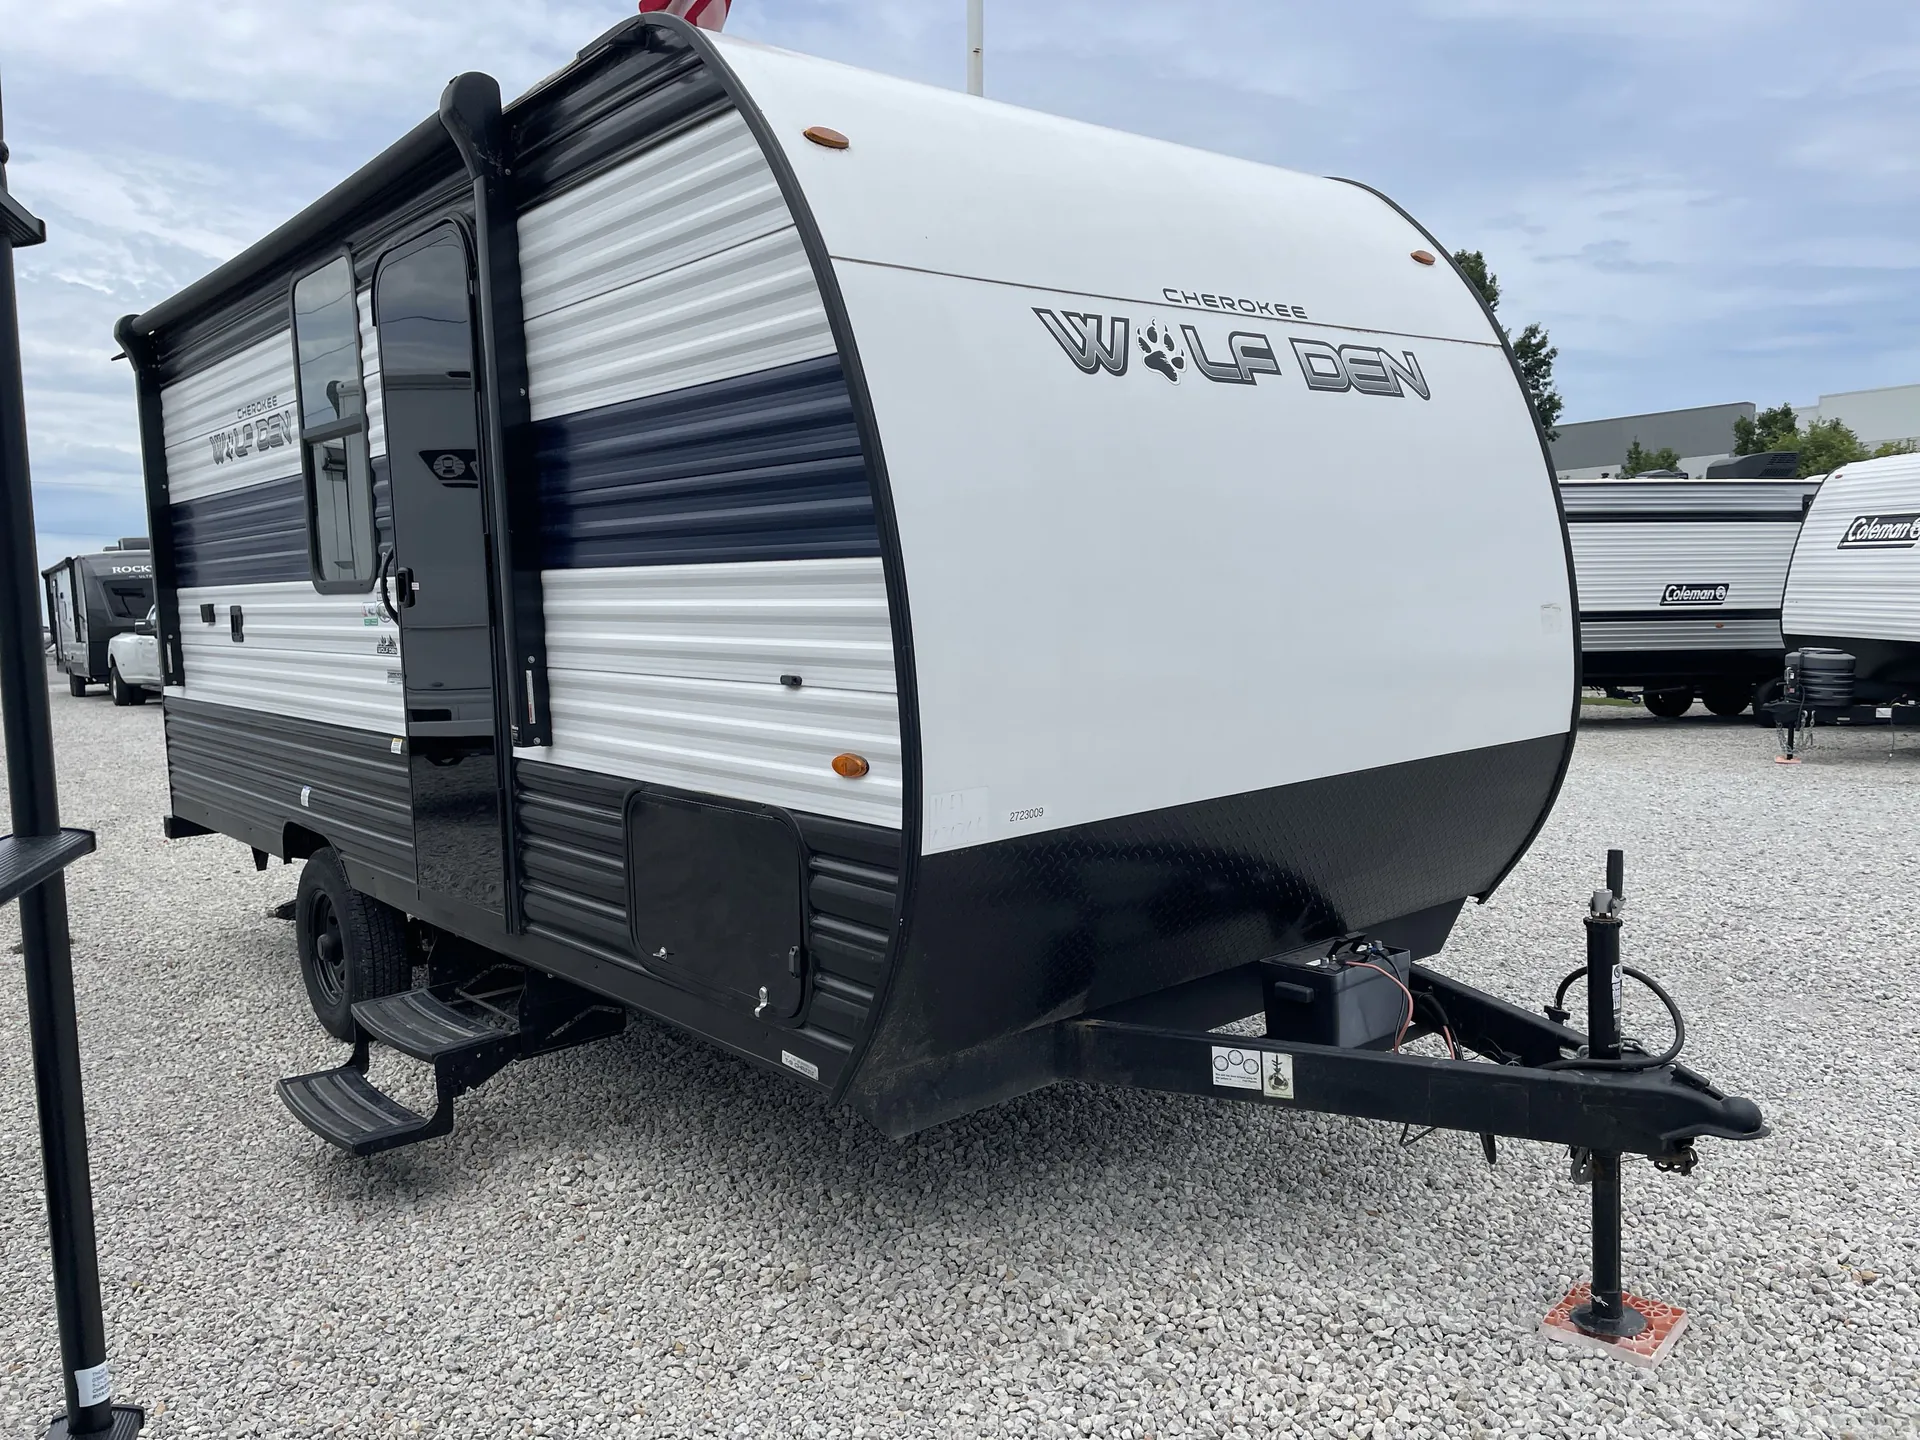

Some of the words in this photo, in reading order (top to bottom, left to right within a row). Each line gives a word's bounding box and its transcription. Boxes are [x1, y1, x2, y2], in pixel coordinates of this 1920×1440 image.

[1162, 287, 1308, 320] CHEROKEE
[1288, 336, 1431, 401] DEN
[237, 395, 278, 419] CHEROKEE
[255, 410, 293, 452] DEN
[1847, 517, 1912, 542] Coleman
[1665, 585, 1715, 601] Coleman
[1009, 807, 1044, 823] 2723009
